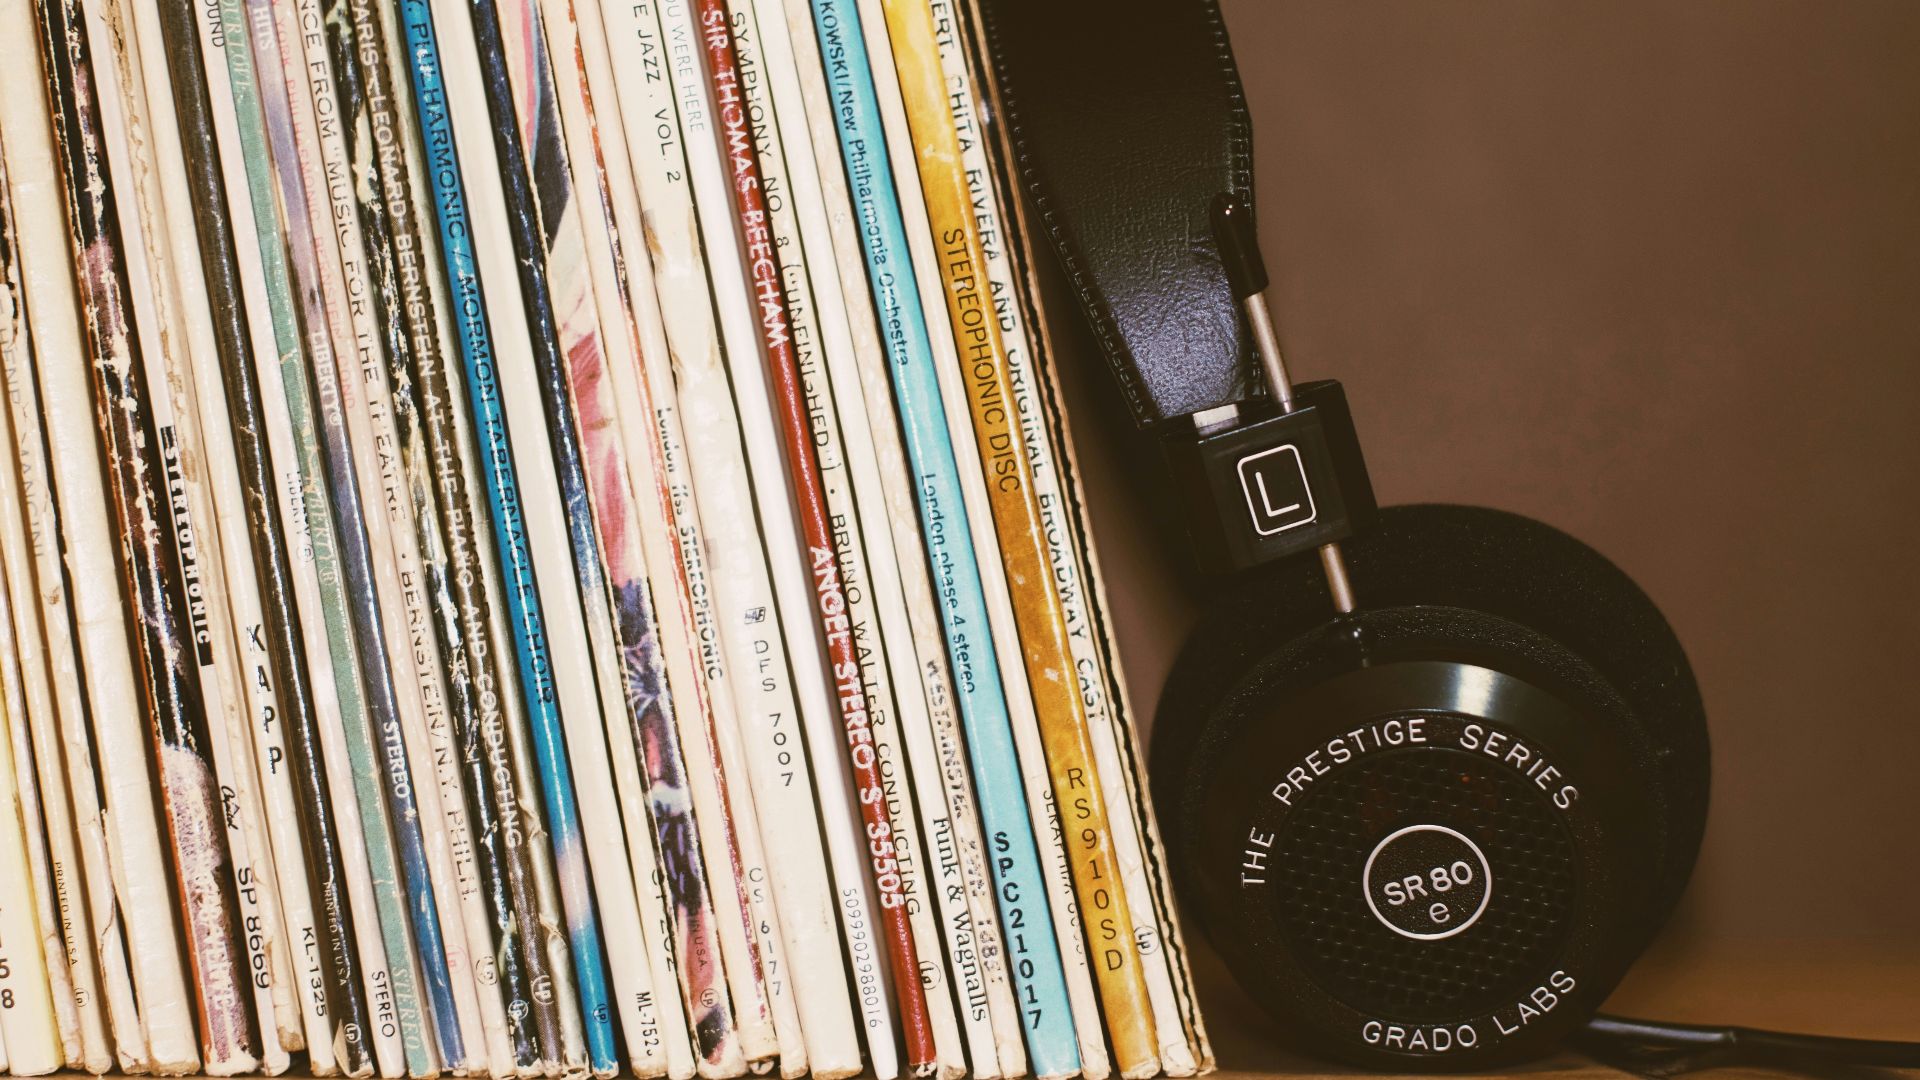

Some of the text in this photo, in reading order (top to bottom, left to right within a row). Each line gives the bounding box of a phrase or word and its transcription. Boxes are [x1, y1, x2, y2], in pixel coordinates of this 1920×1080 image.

[252, 5, 276, 50] HITS
[669, 24, 693, 77] WERE
[681, 83, 704, 133] HERE
[368, 94, 407, 218] LEONARD
[653, 108, 676, 161] VOL.
[666, 169, 681, 183] 2
[308, 60, 337, 139] FROM
[343, 260, 368, 317] FOR
[356, 330, 380, 383] THE
[847, 137, 890, 266] Philharmonia
[394, 232, 435, 377] BERNSTEIN
[876, 272, 912, 367] Orchestra
[410, 22, 466, 240] PHILHARMONIC
[457, 275, 497, 403] MORMON
[484, 413, 533, 601] TABERNACLE
[521, 611, 553, 705] CHOIR
[941, 227, 1021, 494] STEREOPHONIC DISC
[424, 392, 445, 428] AT
[965, 168, 1000, 261] RIVERA
[989, 277, 1017, 333] AND
[1005, 347, 1049, 478] ORIGINAL
[1037, 492, 1086, 641] BROADWAY
[1075, 656, 1105, 723] CAST
[433, 442, 458, 495] THE
[699, 7, 905, 910] SIR THOMAS BEECHAM ANGEL STEREO S 35505
[728, 11, 773, 159] SYMPHONY
[773, 235, 789, 249] 8
[829, 513, 862, 606] BRUNO
[851, 620, 887, 727] WALTER
[873, 741, 923, 916] CONDUCTING
[1255, 471, 1300, 518] L
[163, 446, 211, 645] STEREOPHONIC
[443, 508, 474, 589] PIANO
[918, 473, 949, 546] London
[678, 524, 724, 681] STEREOPHONIC
[932, 551, 961, 610] phase
[949, 612, 965, 627] 4
[462, 602, 488, 658] AND
[951, 632, 978, 695] stereo
[246, 624, 282, 774] KAPP
[754, 639, 794, 786] DFS 7007
[381, 720, 411, 799] STEREO
[475, 672, 523, 849] CONDUCTING
[1240, 718, 1580, 889] THE PRESTIGE SERIES
[219, 783, 242, 831] Capitol
[53, 861, 69, 913] PRINTED
[63, 917, 72, 930] IN
[236, 866, 272, 990] SP 8669
[320, 881, 337, 933] PRINTED
[331, 938, 340, 951] IN
[930, 815, 991, 1024] Funk & Wagnalls
[1428, 902, 1451, 924] e
[301, 926, 327, 1017] KL-1325
[370, 970, 395, 1038] STEREO
[841, 887, 883, 1029] 5099902988016
[391, 964, 422, 1050] STEREO
[1362, 970, 1576, 1052] GRADO LABS
